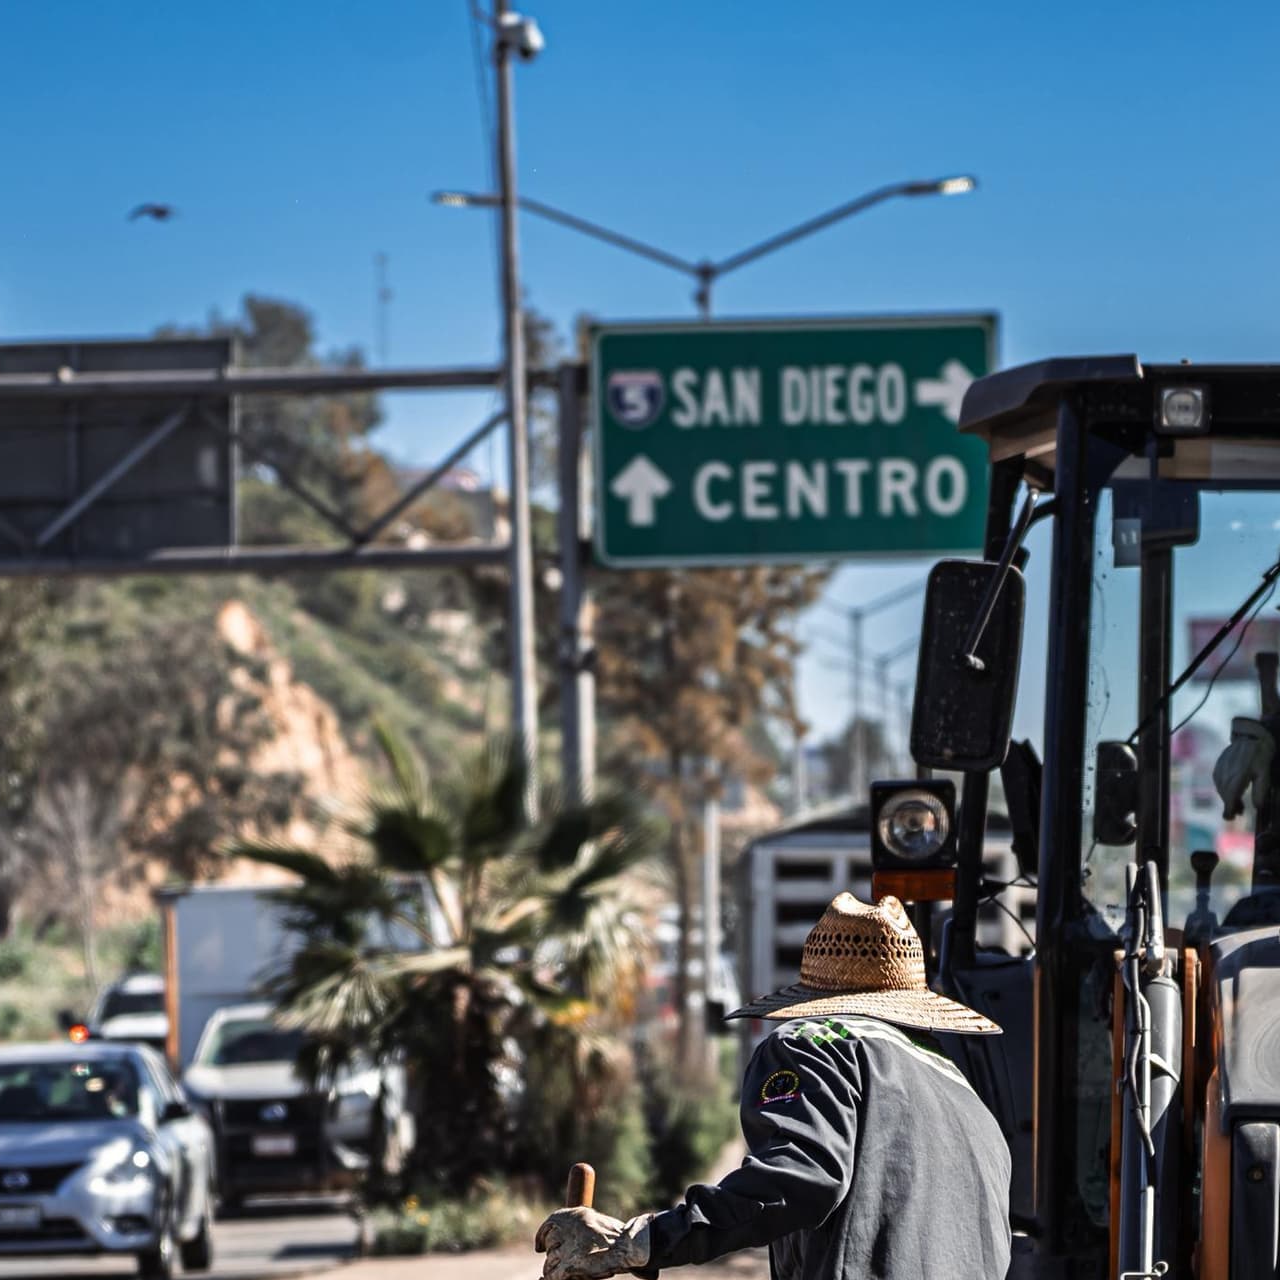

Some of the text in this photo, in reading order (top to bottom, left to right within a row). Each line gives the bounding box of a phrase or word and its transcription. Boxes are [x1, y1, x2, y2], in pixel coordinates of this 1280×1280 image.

[622, 363, 908, 428] 5 SAN DIEGO
[694, 456, 968, 521] CENTRO
